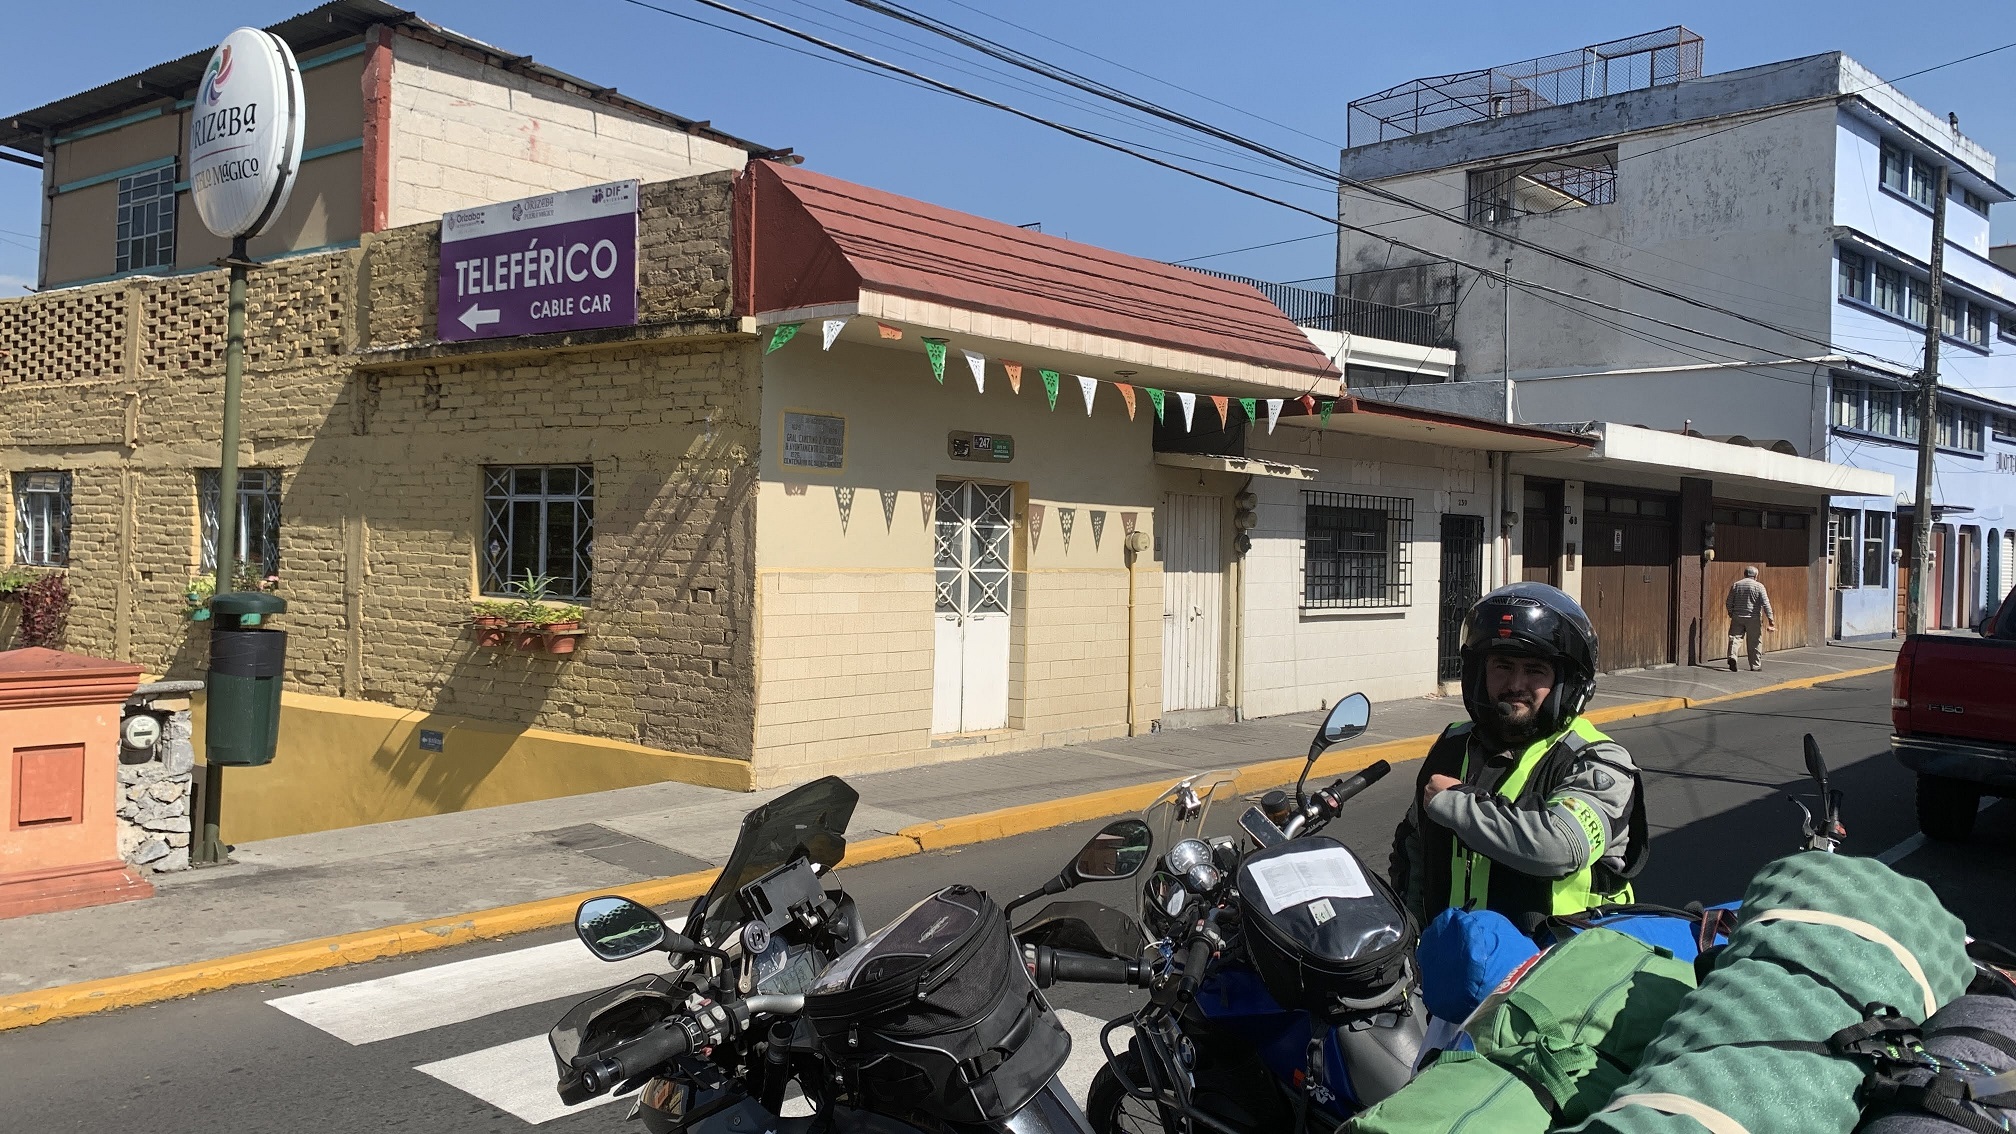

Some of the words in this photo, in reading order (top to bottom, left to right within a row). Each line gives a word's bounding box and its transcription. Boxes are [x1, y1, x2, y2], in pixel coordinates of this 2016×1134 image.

[605, 186, 621, 198] DIF
[455, 238, 618, 297] TELEFÉRICO
[530, 297, 574, 320] CABLE
[579, 294, 612, 314] CAR
[978, 437, 991, 449] 247
[1581, 809, 1602, 849] RRM
